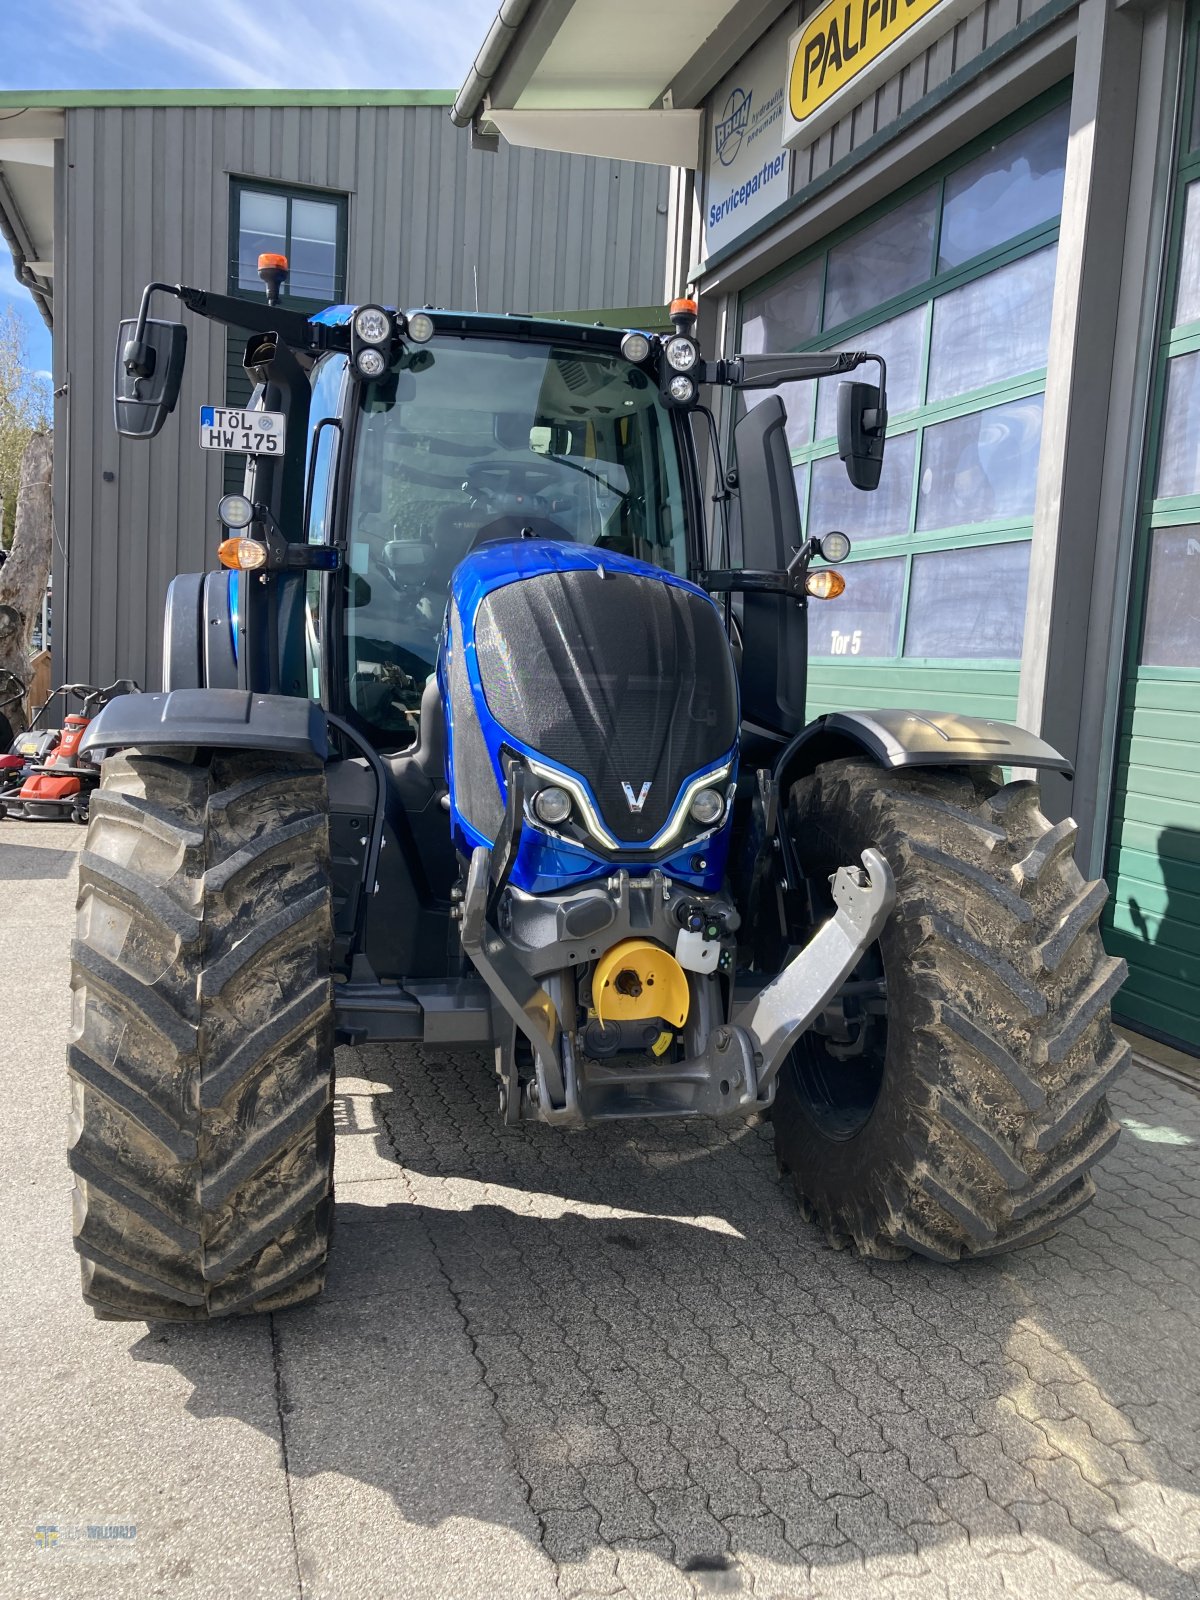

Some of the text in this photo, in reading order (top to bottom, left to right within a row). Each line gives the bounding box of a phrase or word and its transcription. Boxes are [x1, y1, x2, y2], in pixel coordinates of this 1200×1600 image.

[709, 151, 787, 228] Servicepartner
[215, 410, 253, 431] TÖL
[209, 425, 277, 452] HW 175
[830, 630, 862, 654] Tor 5
[621, 781, 652, 812] V
